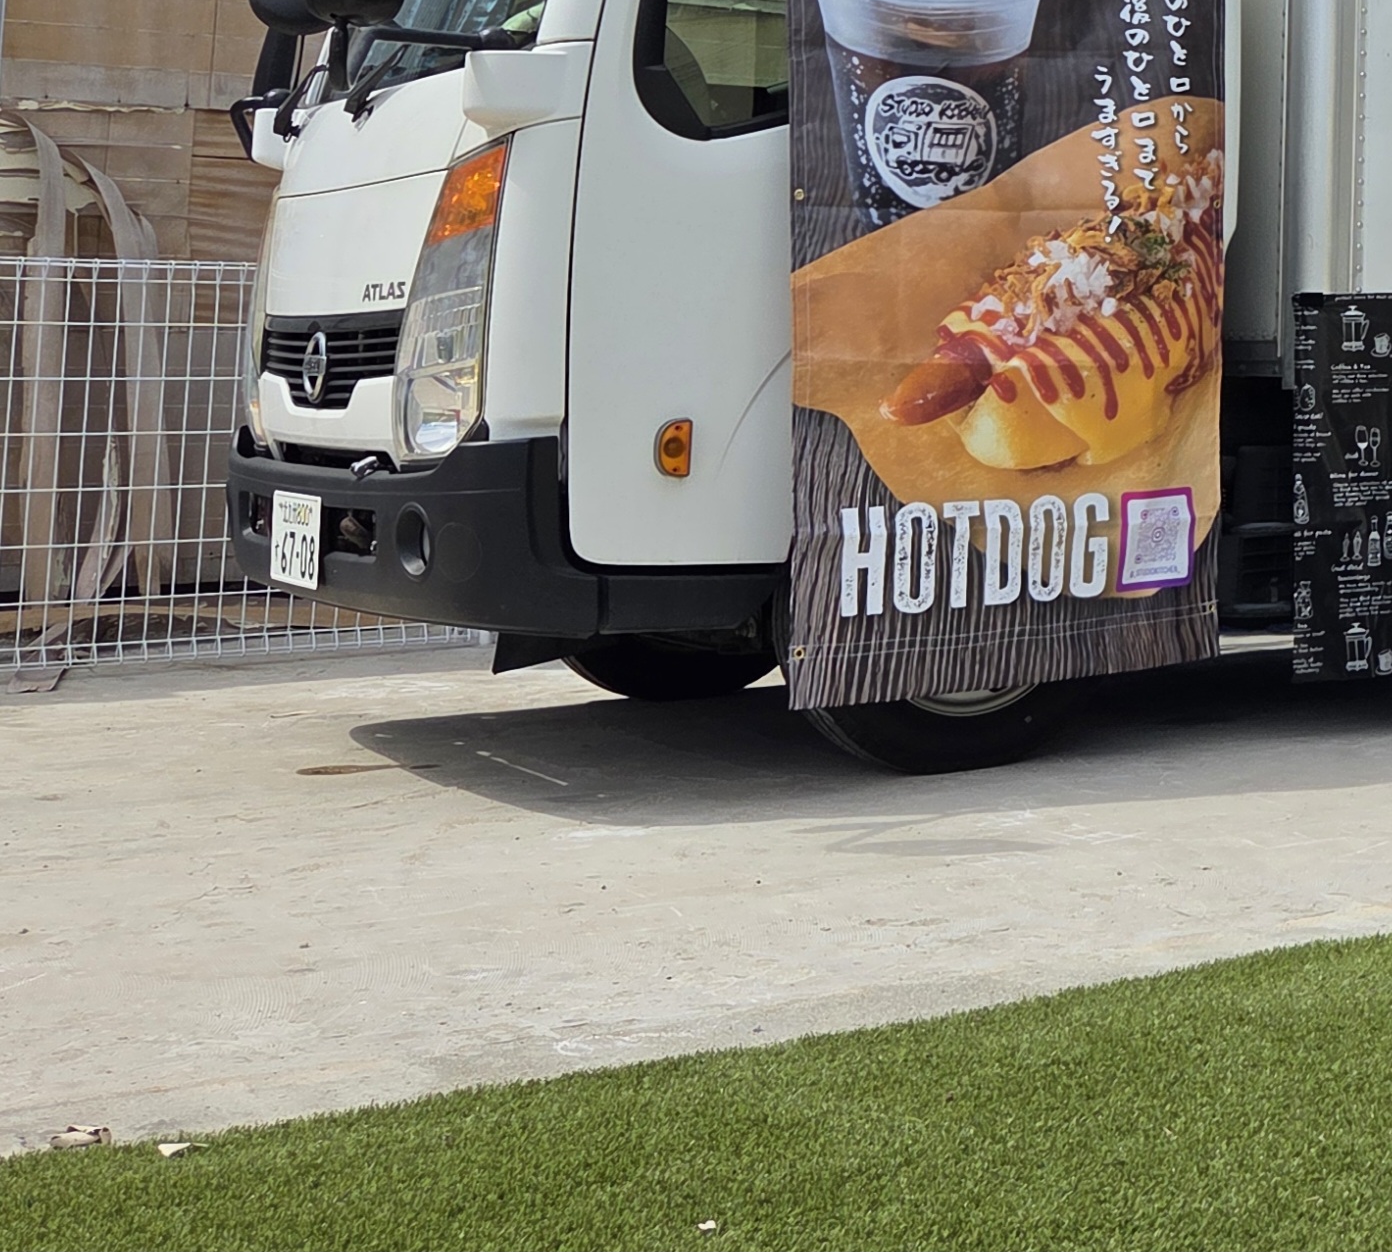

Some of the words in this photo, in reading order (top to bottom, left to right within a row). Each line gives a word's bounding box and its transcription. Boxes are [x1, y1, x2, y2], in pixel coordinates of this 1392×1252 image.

[880, 93, 934, 118] STUDIO
[1091, 65, 1126, 244] うますぎる!
[362, 281, 406, 302] ATLAS
[281, 531, 316, 580] 67-08
[840, 493, 1110, 618] HOTDOG
